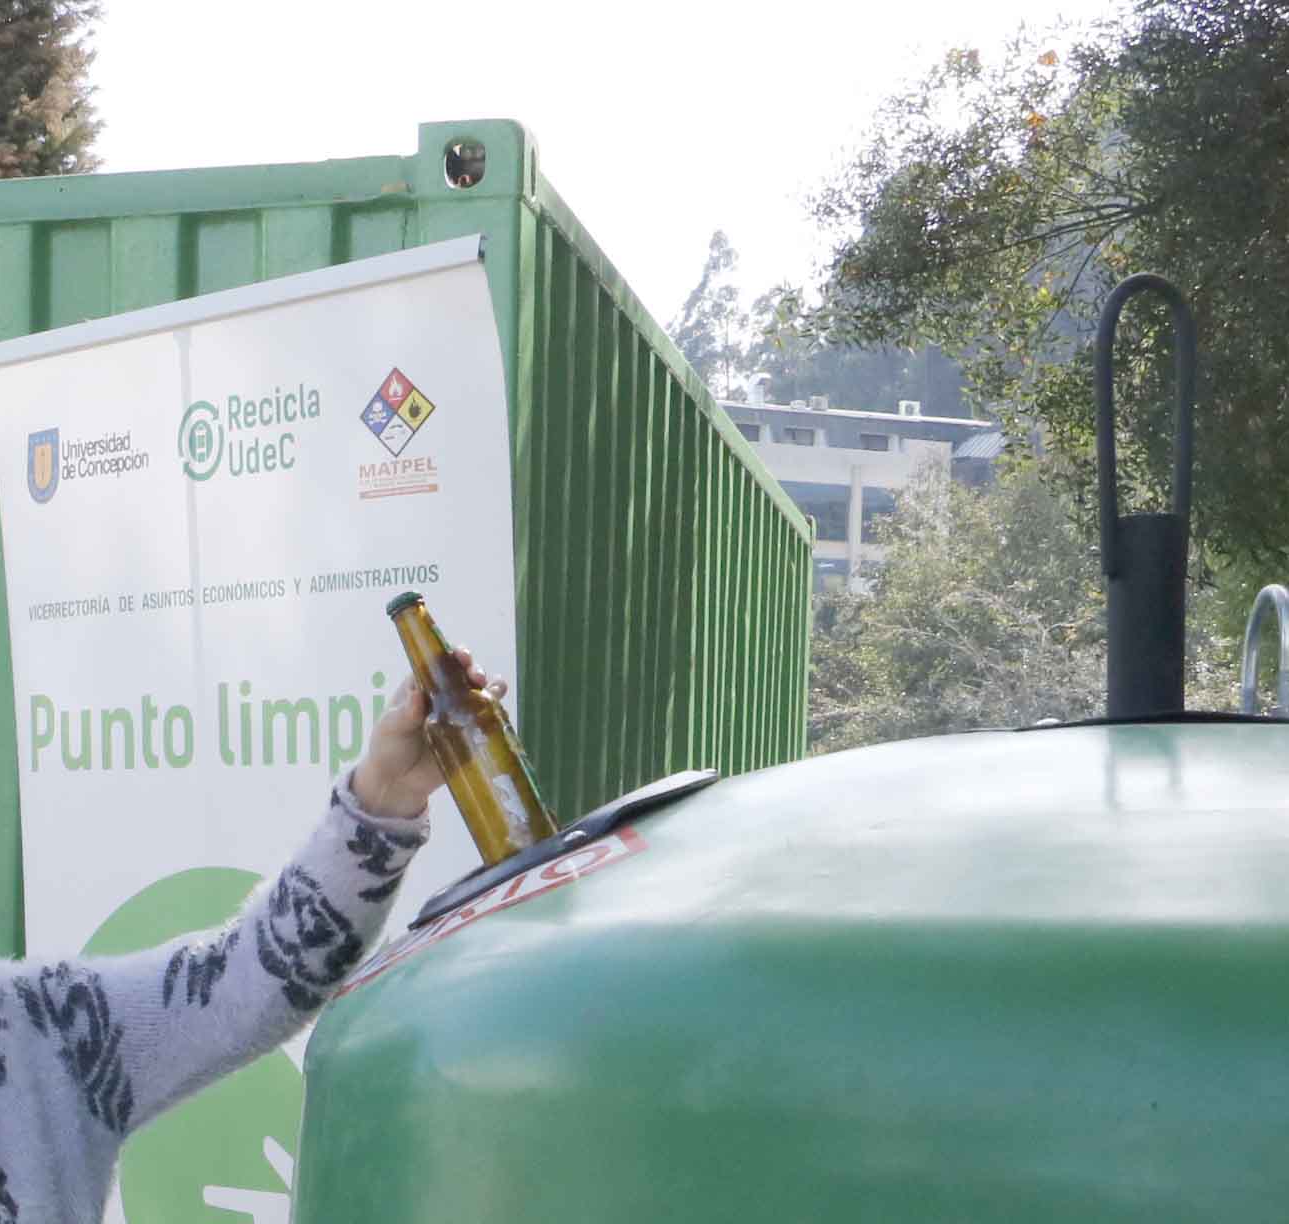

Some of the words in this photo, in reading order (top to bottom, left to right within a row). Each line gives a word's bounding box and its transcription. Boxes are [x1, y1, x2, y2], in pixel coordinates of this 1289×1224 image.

[227, 383, 322, 431] Recicla
[61, 430, 131, 461] Universidad
[61, 458, 77, 481] de
[78, 448, 150, 479] Concepción
[227, 434, 296, 478] UdeC
[358, 457, 438, 480] MATPEL
[28, 594, 111, 622] VICERRECTORÍA
[118, 595, 135, 613] DE
[141, 588, 195, 610] ASUNTOS
[202, 579, 286, 605] ECONÓMICOS
[293, 577, 302, 595] Y
[308, 564, 440, 594] ADMINISTRATIVOS
[29, 692, 195, 773] Punto
[217, 671, 387, 778] limpi
